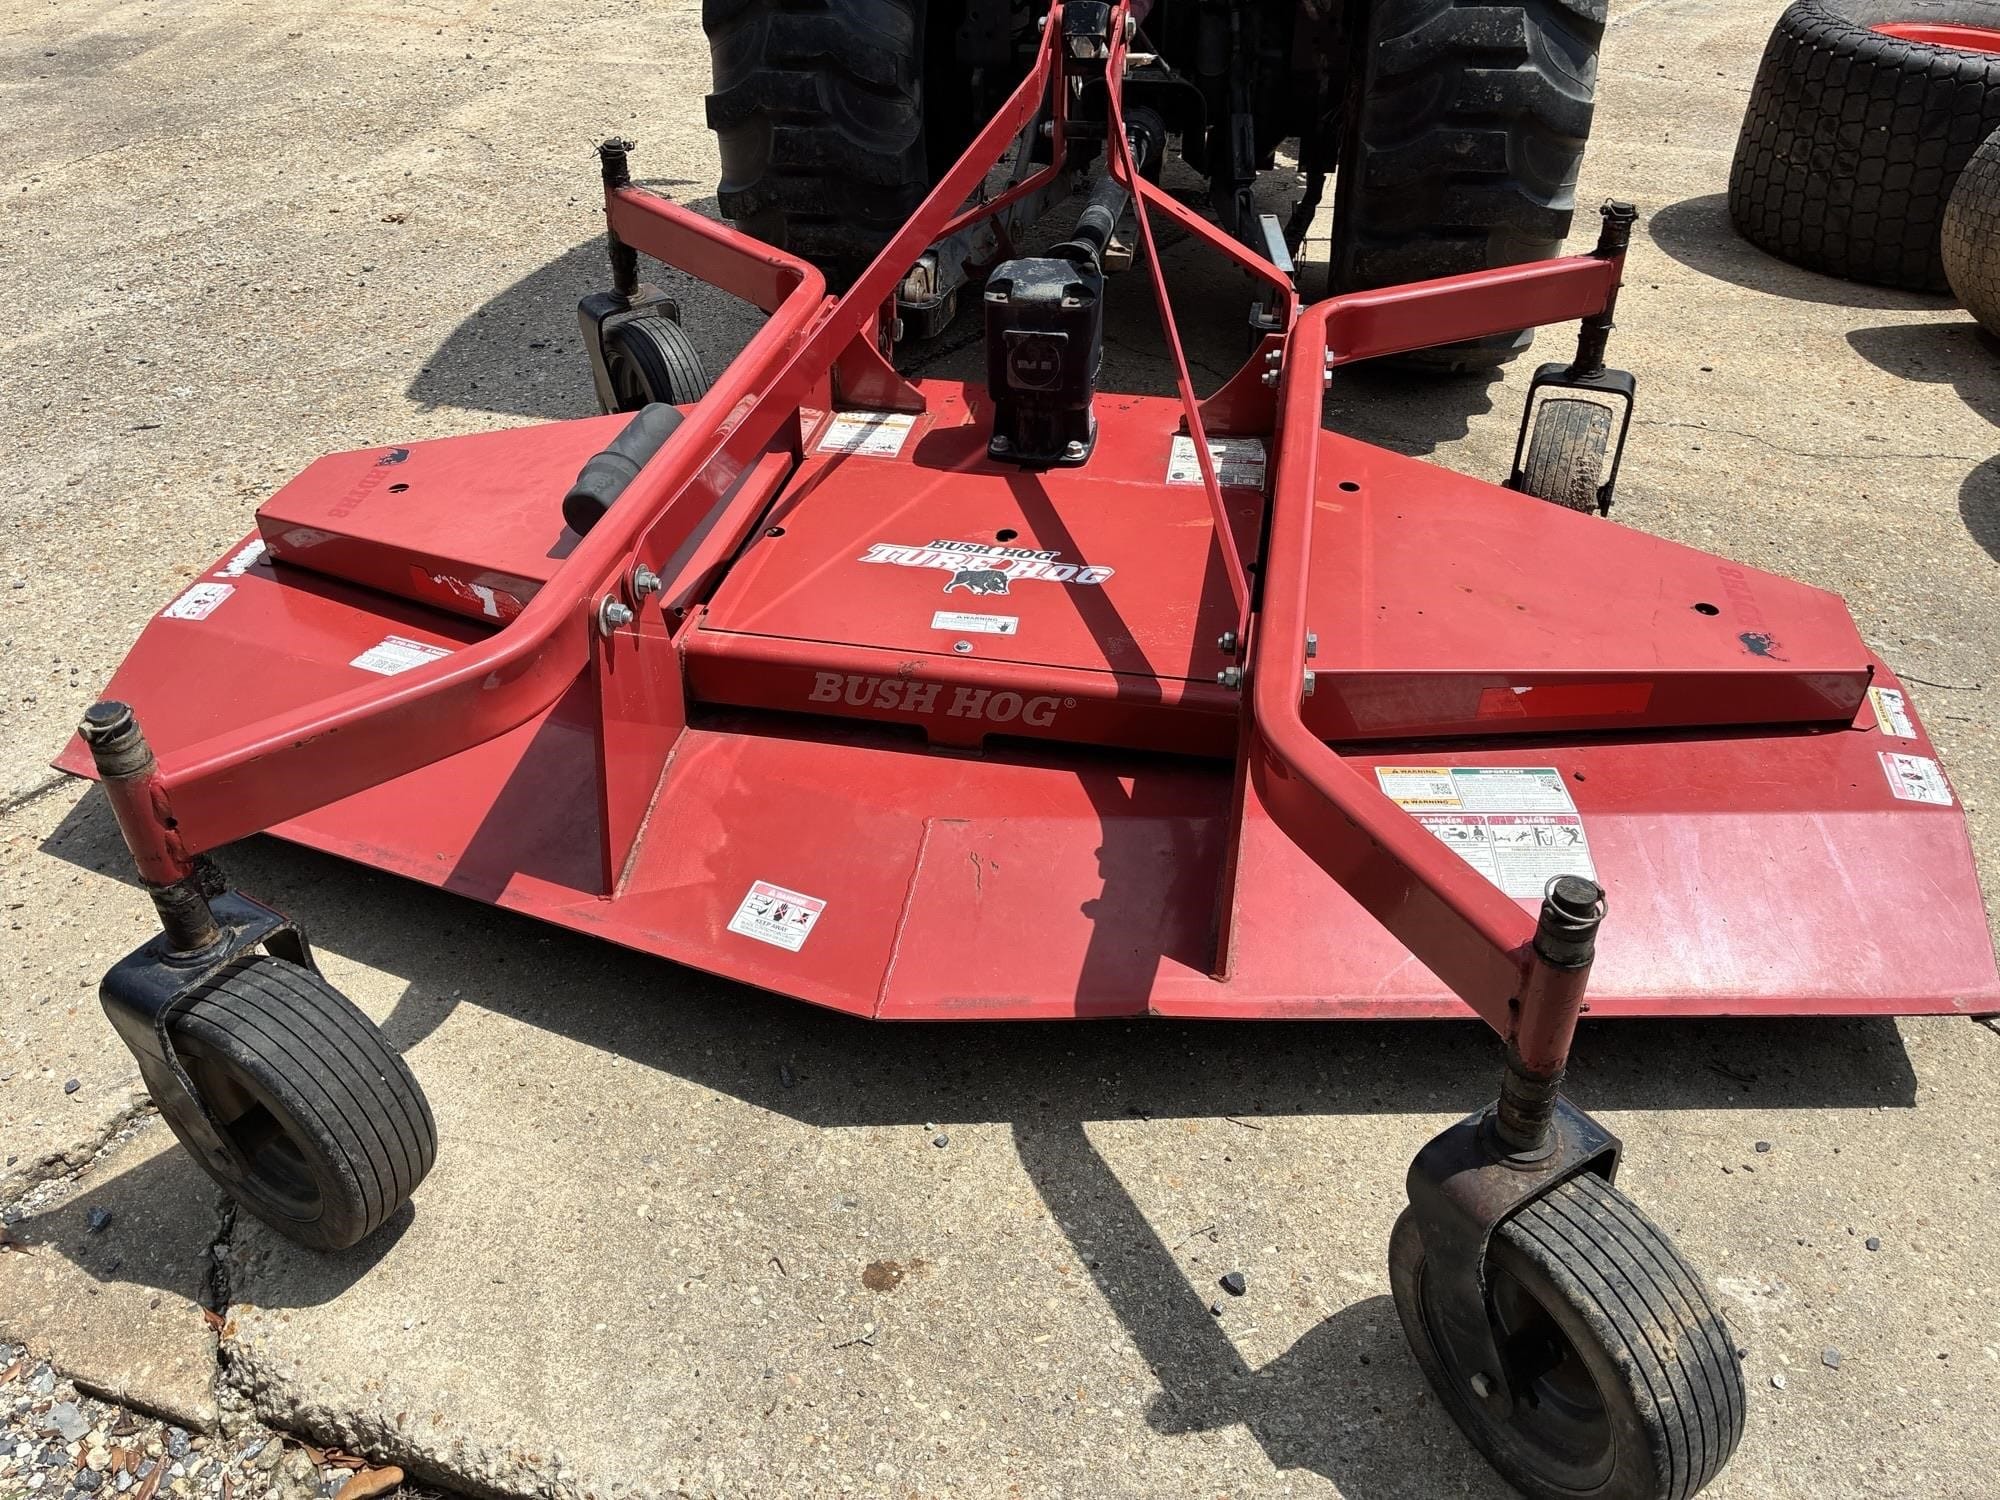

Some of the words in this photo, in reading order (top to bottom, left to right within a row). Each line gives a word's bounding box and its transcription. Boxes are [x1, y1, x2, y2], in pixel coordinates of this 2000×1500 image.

[862, 544, 1007, 571] TURF
[1008, 558, 1113, 585] HOG
[929, 540, 990, 555] BUSH
[1001, 547, 1055, 561] HOG
[808, 672, 943, 714] BUSH
